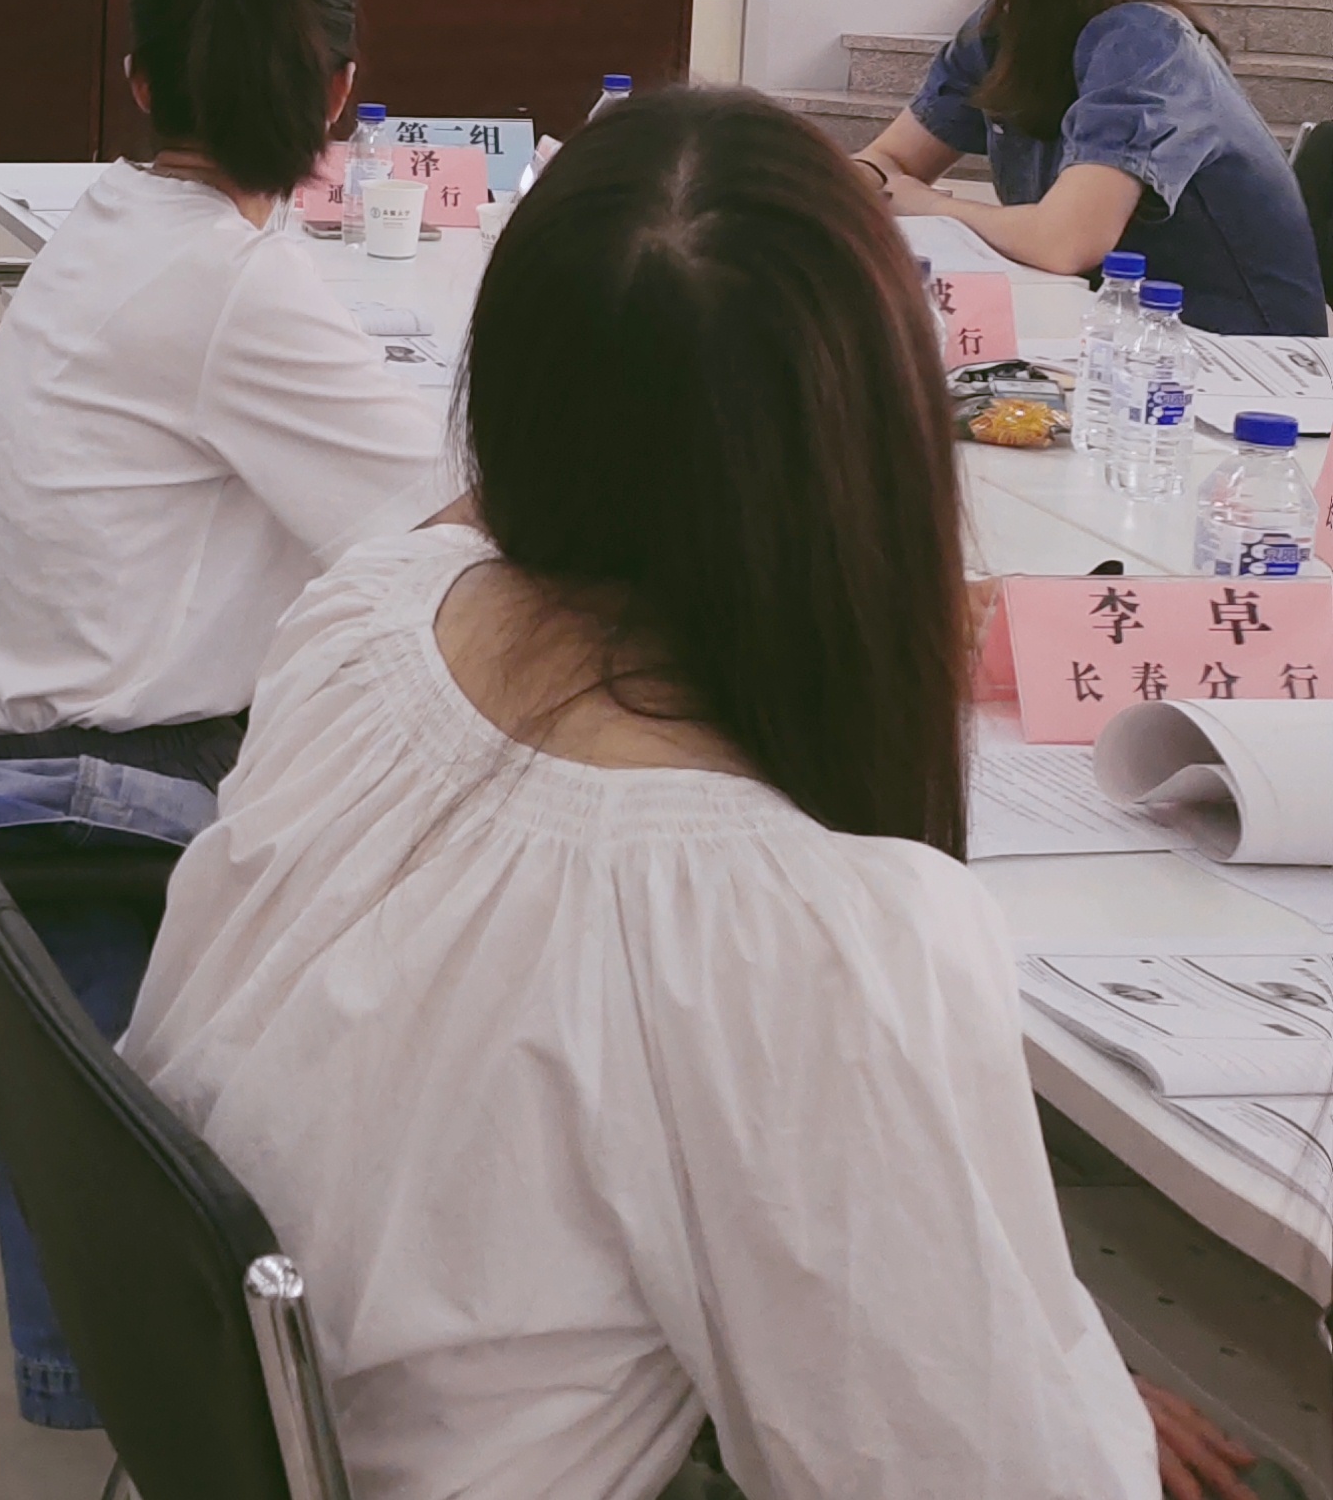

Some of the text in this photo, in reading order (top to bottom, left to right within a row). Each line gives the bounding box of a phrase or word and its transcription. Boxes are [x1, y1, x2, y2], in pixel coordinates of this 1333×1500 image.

[1088, 586, 1272, 645] 李卓
[1066, 661, 1318, 701] 长春分行
